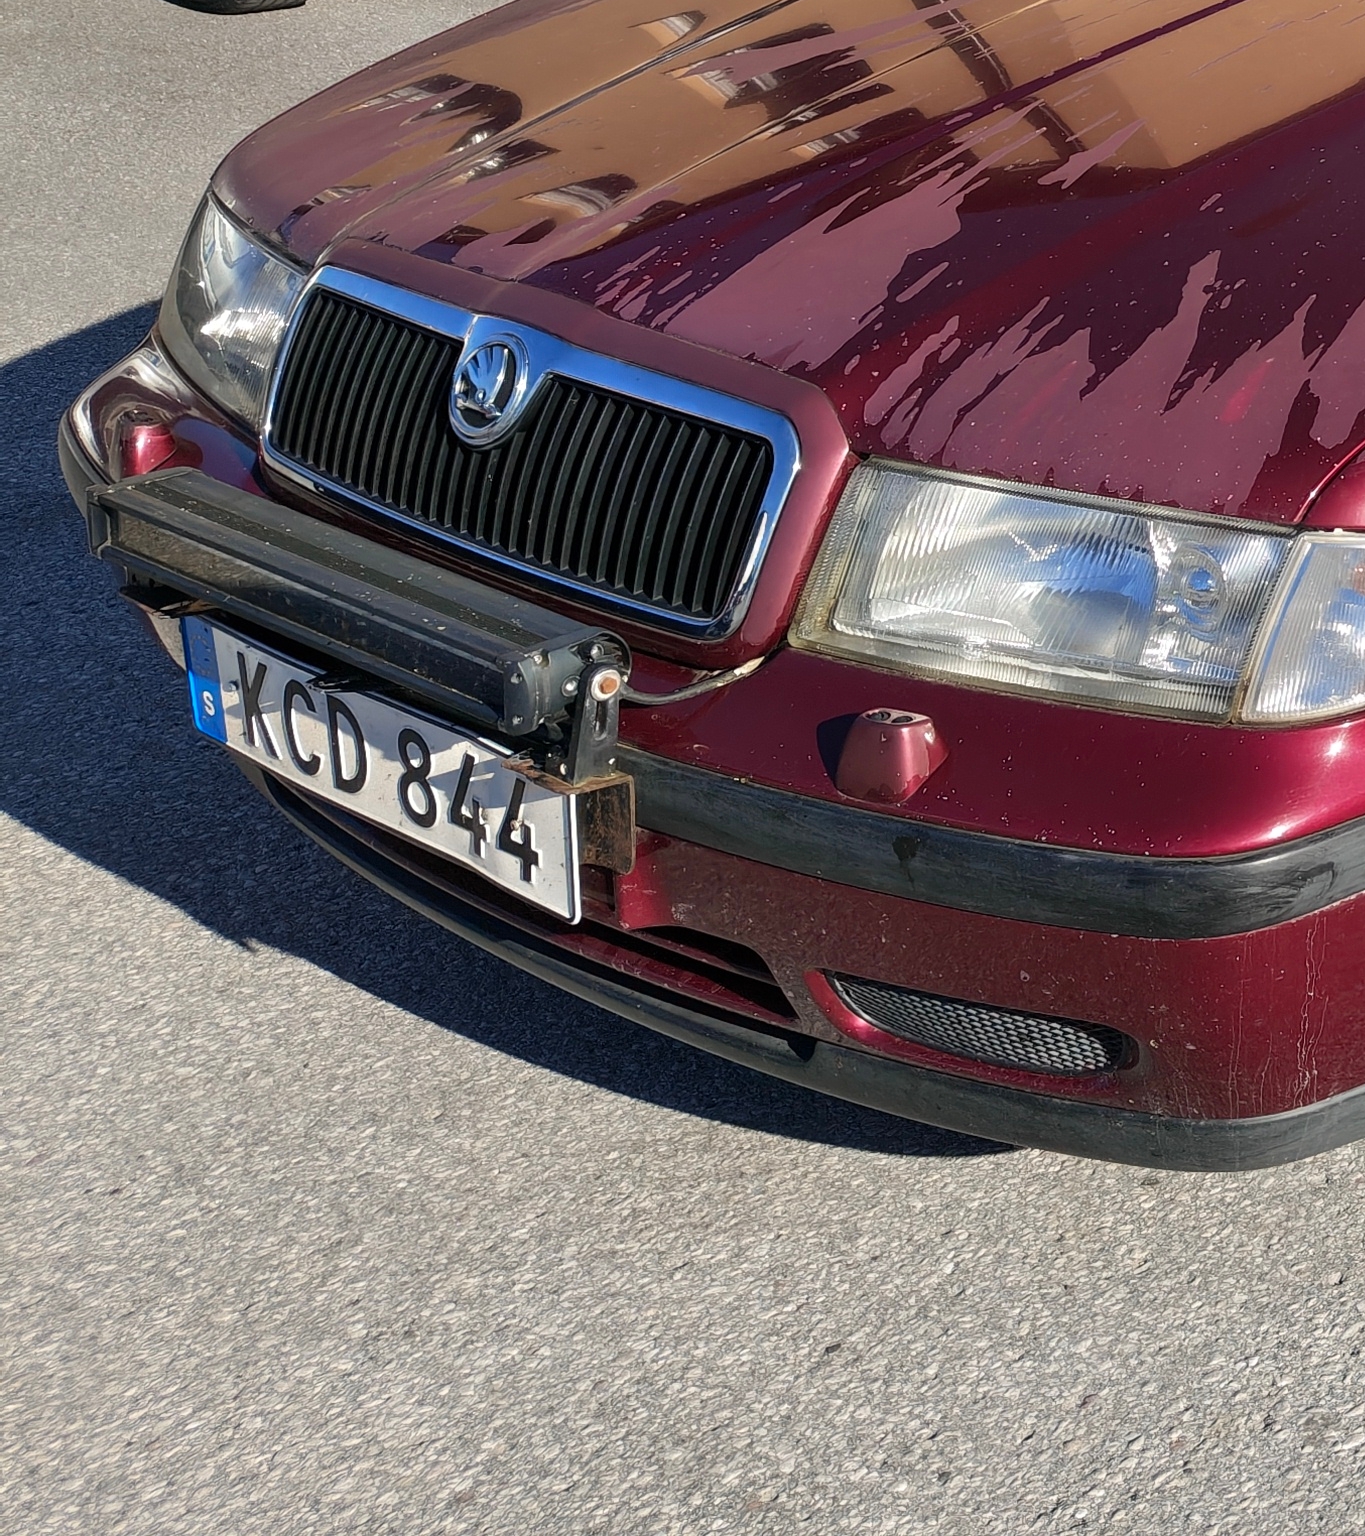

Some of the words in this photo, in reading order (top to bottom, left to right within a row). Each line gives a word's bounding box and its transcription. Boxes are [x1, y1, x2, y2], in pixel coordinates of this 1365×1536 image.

[203, 689, 217, 717] S
[236, 650, 369, 795] KCD
[397, 727, 544, 885] 844
